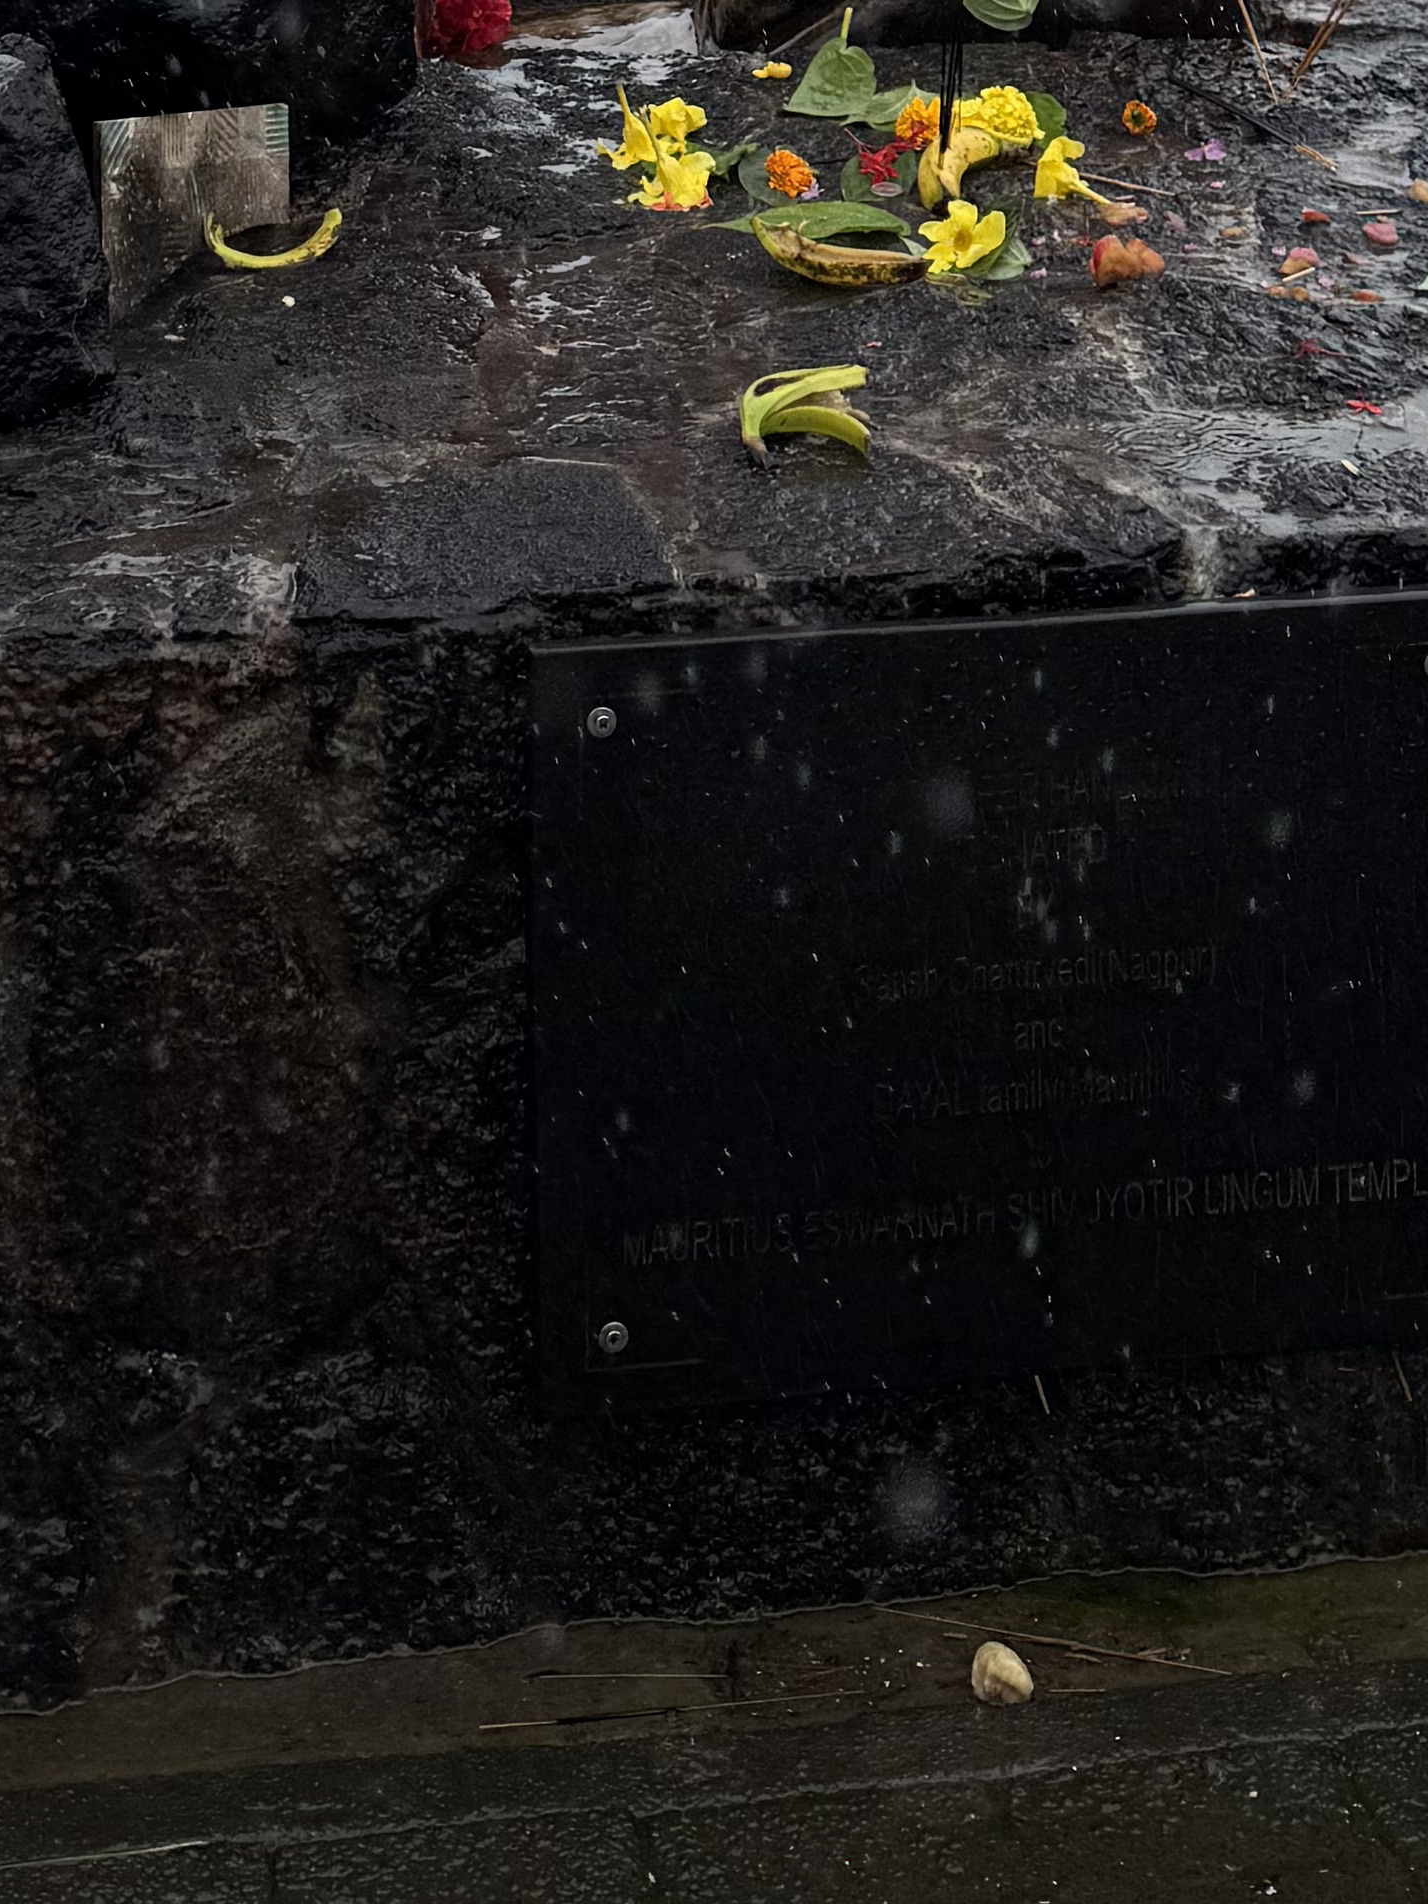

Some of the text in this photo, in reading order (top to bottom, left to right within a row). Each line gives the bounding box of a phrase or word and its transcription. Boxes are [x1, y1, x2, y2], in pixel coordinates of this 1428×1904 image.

[622, 1212, 794, 1266] MAURITIUS
[1088, 1174, 1195, 1224] JYOTIR
[1203, 1166, 1320, 1215] LINGUM
